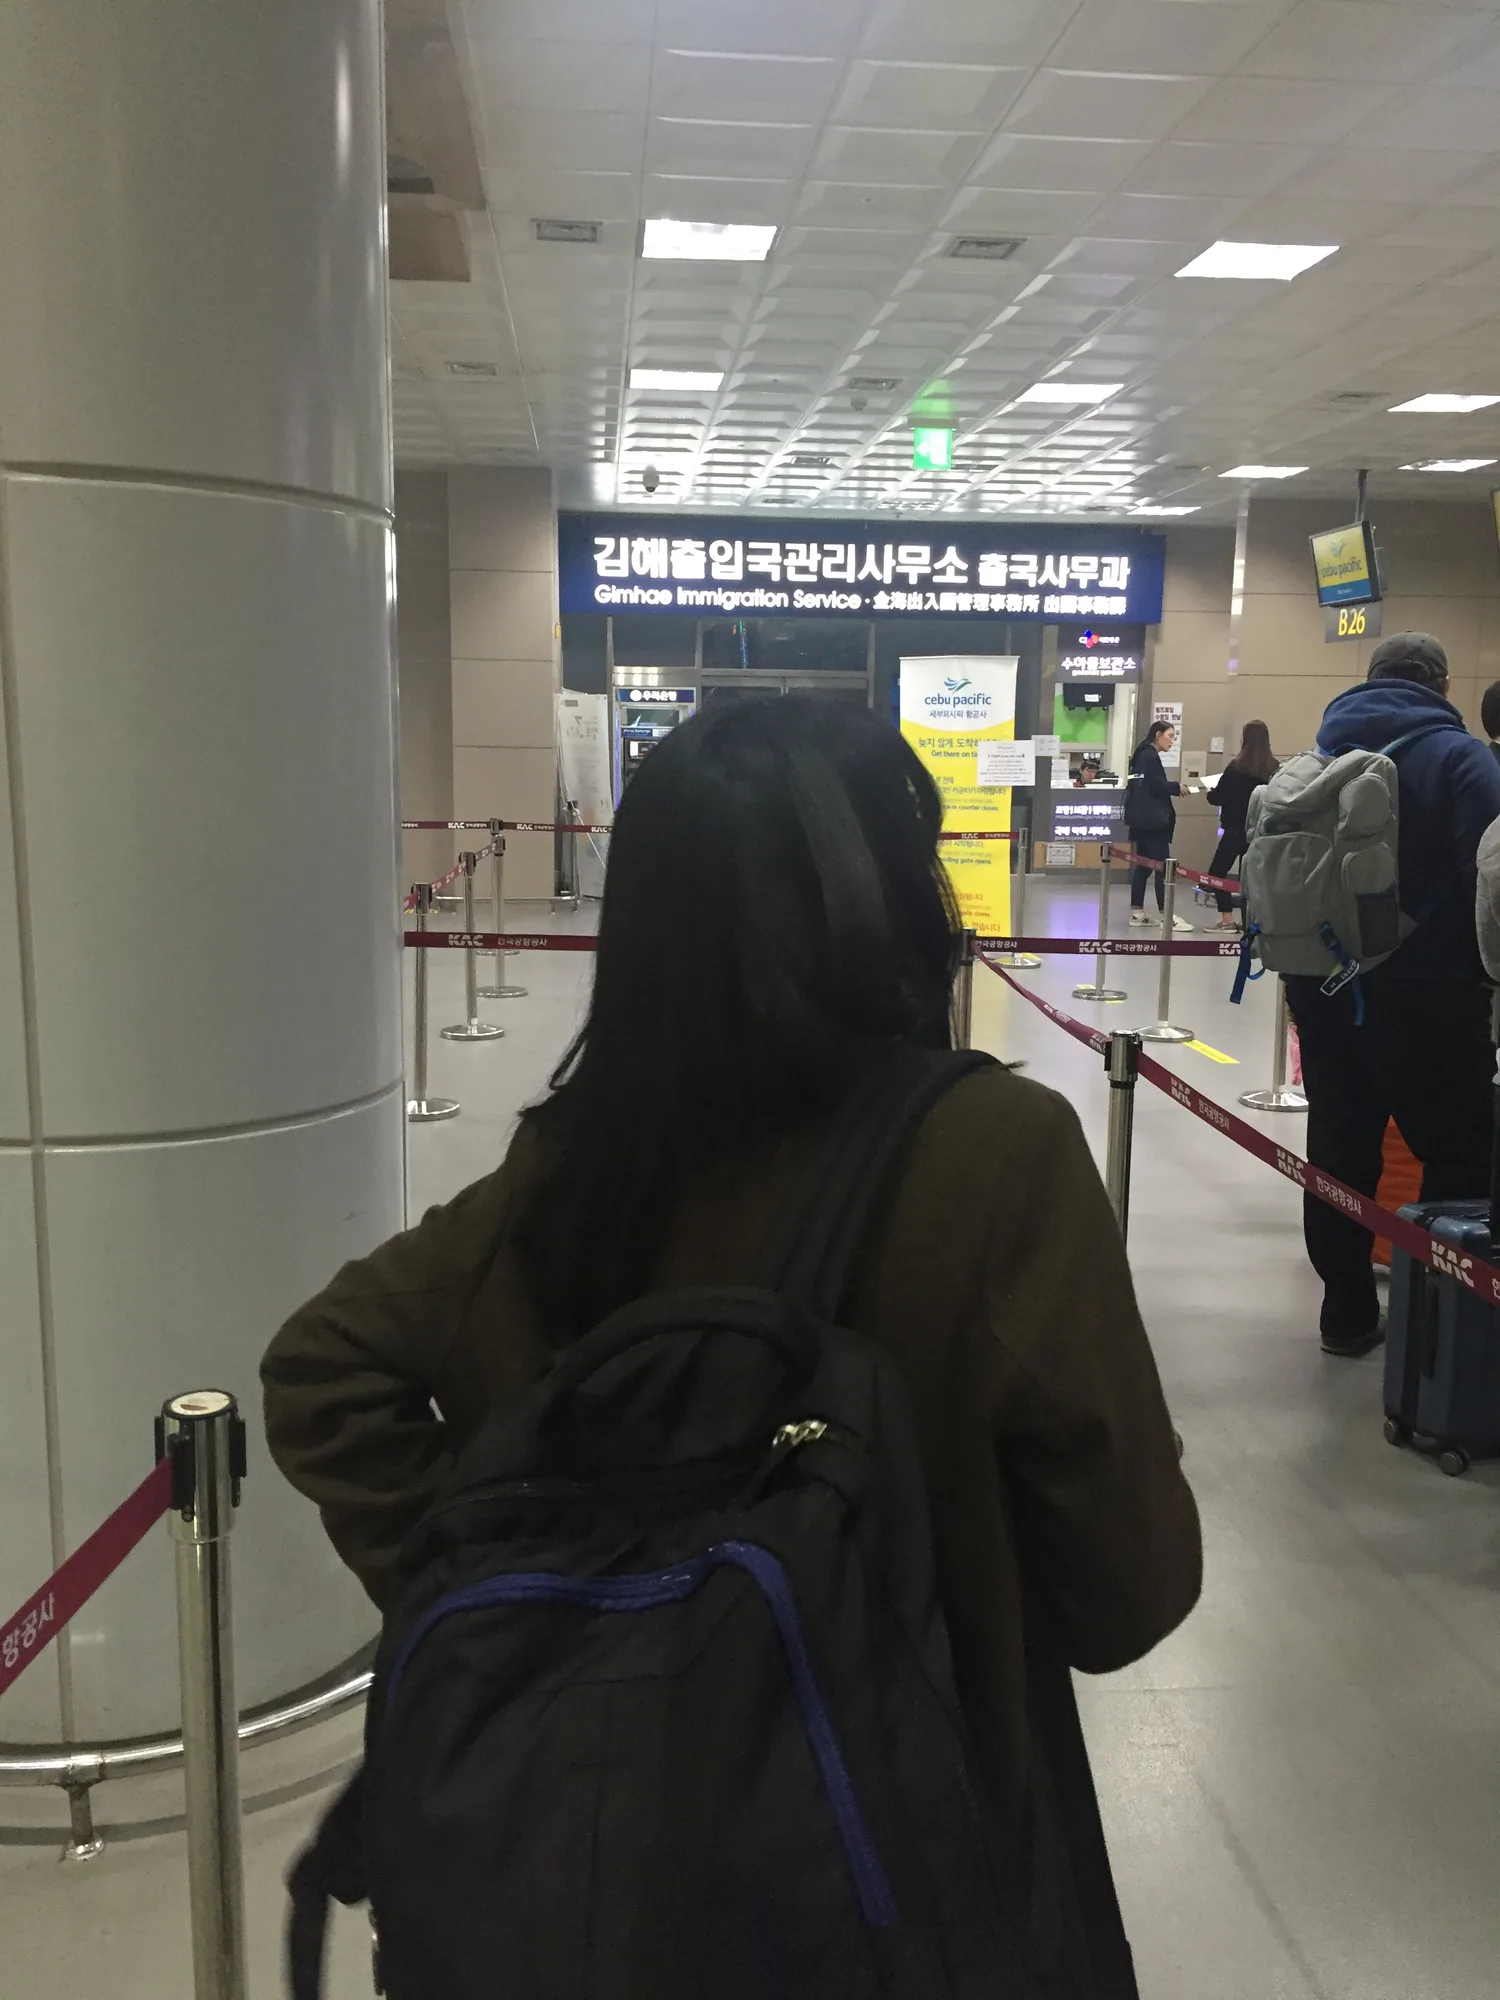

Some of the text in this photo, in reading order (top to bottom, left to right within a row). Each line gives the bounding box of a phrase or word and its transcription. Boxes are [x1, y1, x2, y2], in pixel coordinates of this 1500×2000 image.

[594, 537, 1130, 590] 김해출입국관리사무소 출국사무과
[594, 584, 861, 611] Gimhae Immigration Service
[1338, 608, 1366, 636] B26
[924, 693, 992, 708] cebu pacific
[448, 934, 484, 946] KAC
[1079, 941, 1112, 954] KAC
[1115, 944, 1157, 952] 한국공항공사
[1171, 1077, 1192, 1108] KAC
[1277, 1148, 1306, 1185] KAC
[1316, 1175, 1361, 1216] 한국공항공사
[1431, 1240, 1475, 1288] KAC
